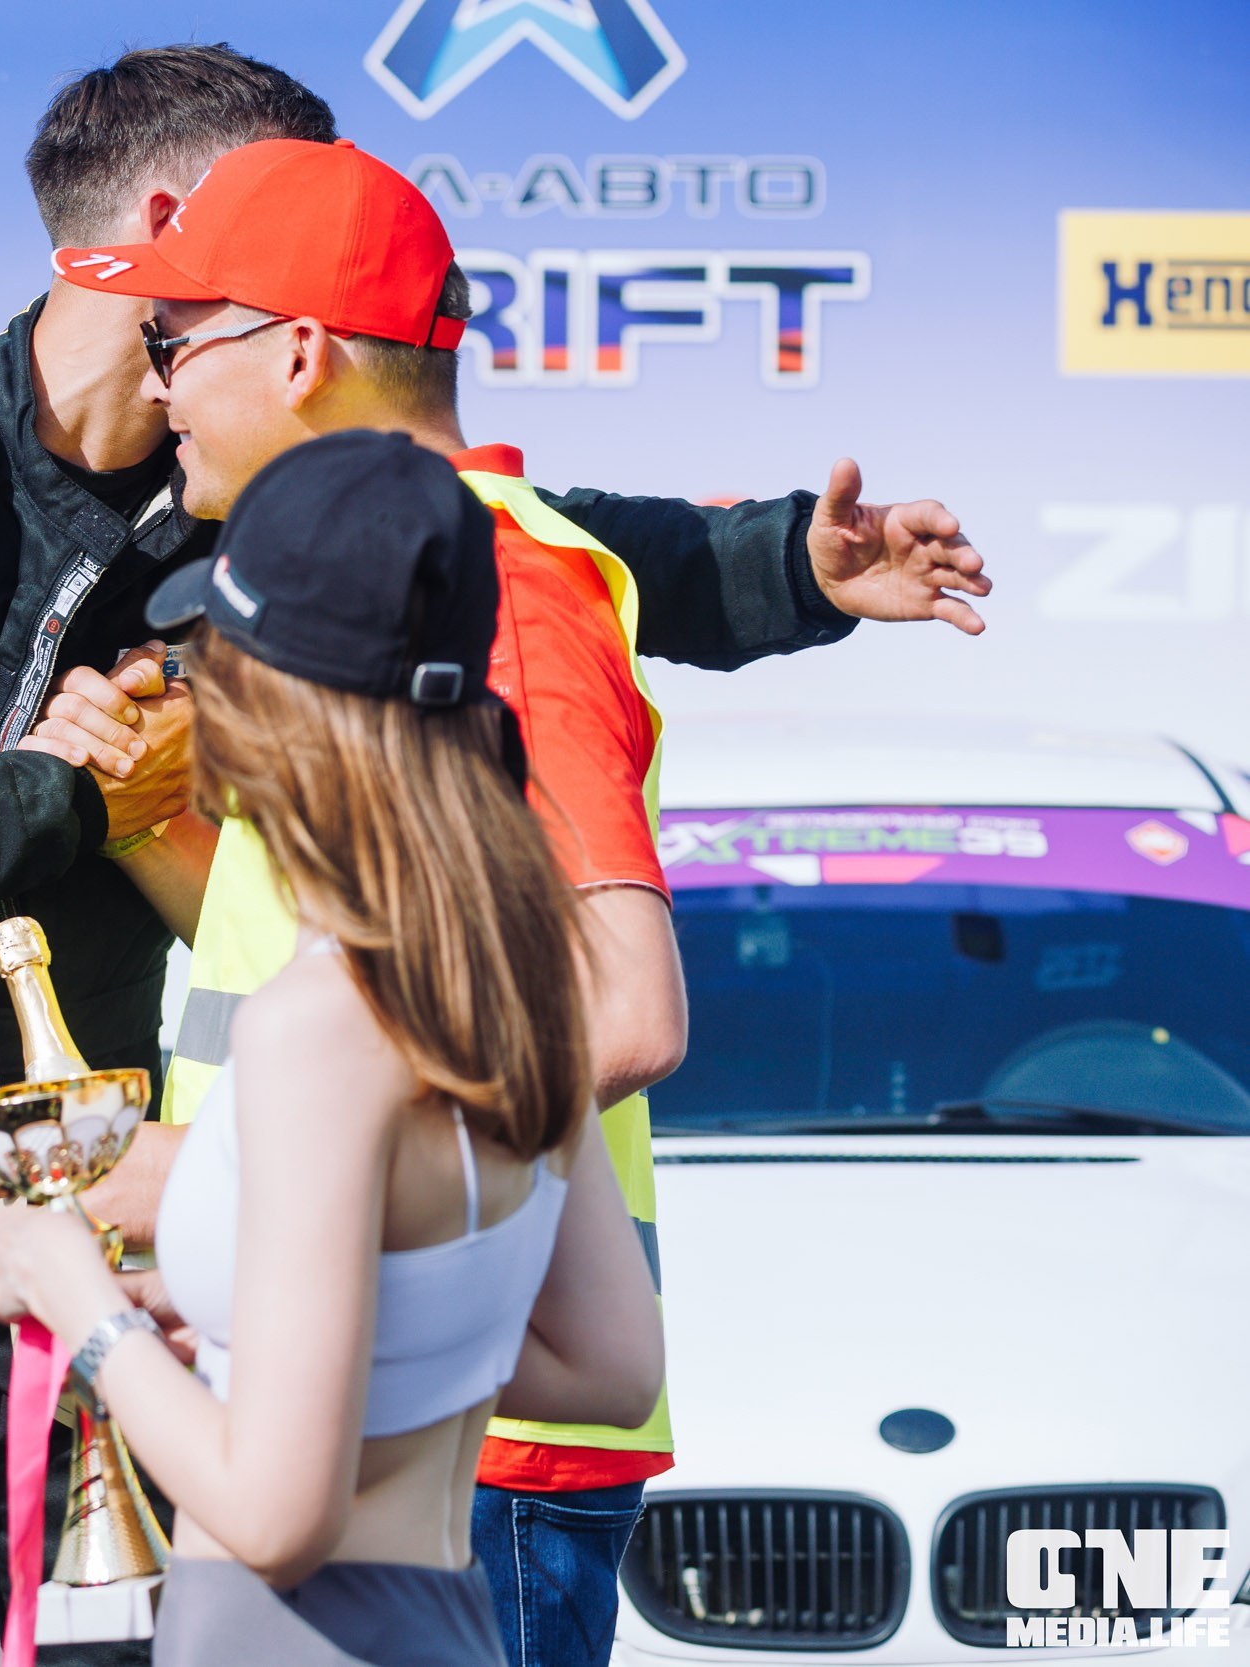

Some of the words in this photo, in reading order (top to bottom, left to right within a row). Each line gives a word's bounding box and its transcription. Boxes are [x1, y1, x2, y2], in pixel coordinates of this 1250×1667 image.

[410, 154, 827, 219] Л-АВТО
[449, 248, 872, 389] RIFT
[1042, 503, 1250, 619] ZI
